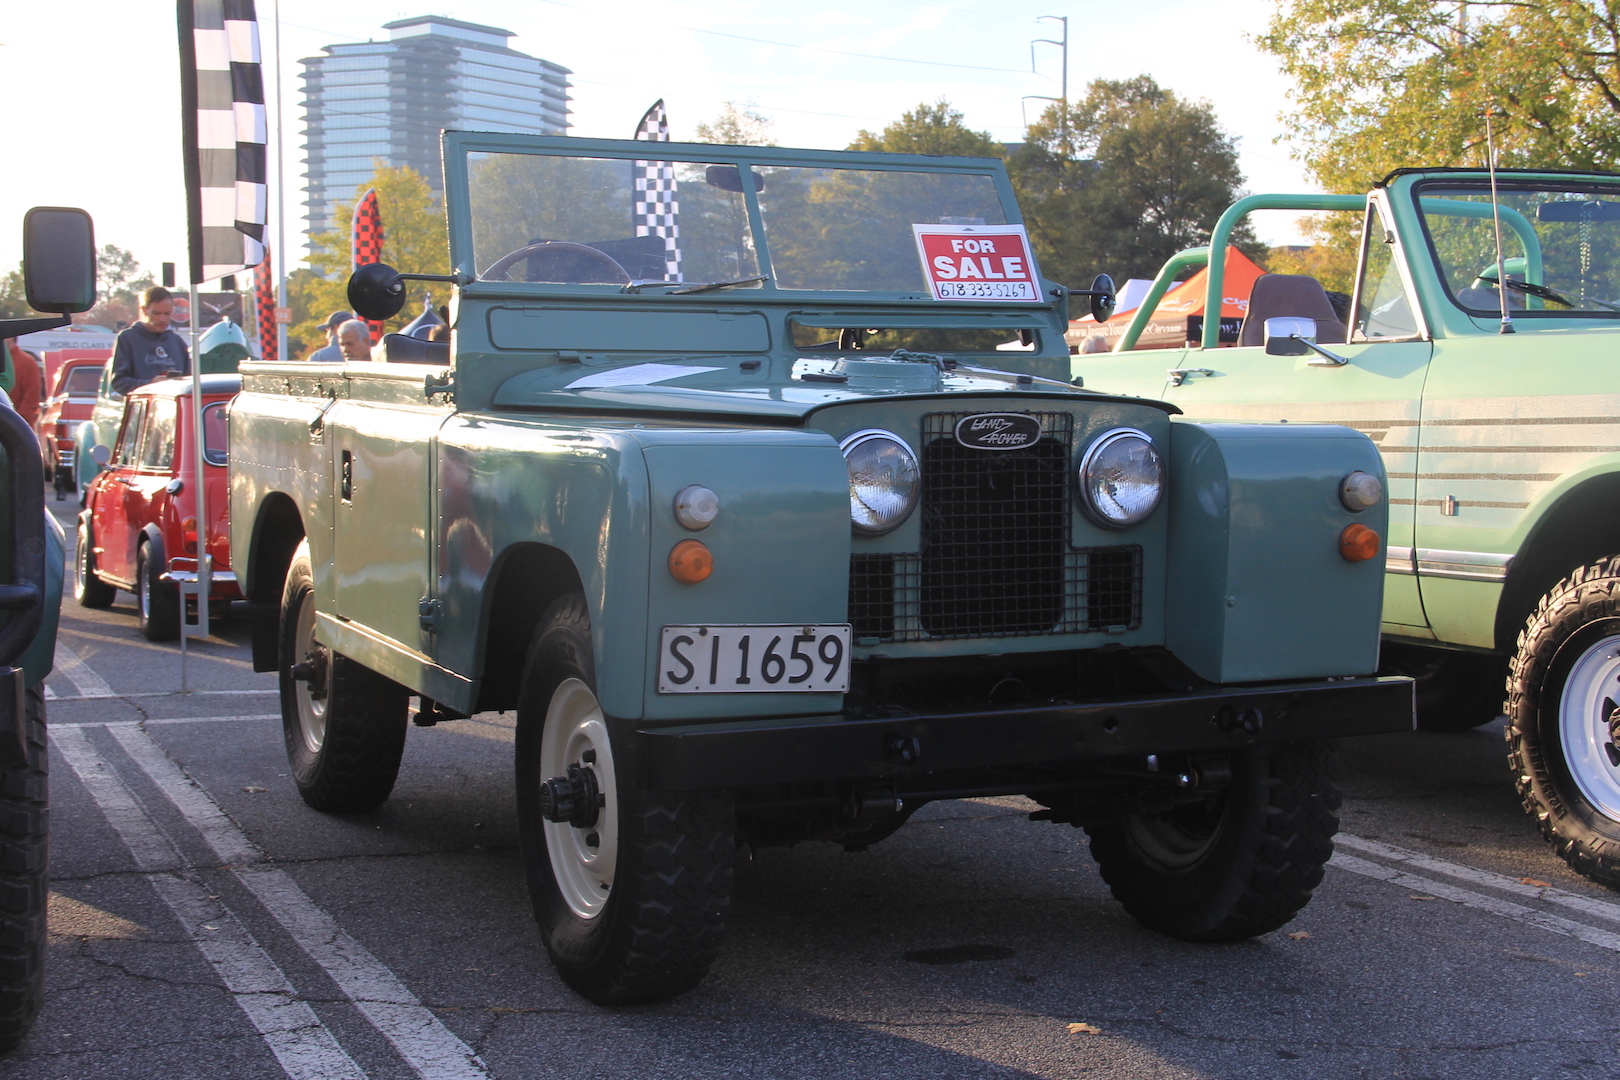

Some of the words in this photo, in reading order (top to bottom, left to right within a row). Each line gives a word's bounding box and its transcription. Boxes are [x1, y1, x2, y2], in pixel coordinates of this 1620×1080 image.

[951, 239, 996, 253] FOR
[933, 255, 1026, 279] SALE
[941, 283, 1026, 297] 678-333-5269
[49, 341, 79, 349] WORLD
[970, 418, 1005, 431] LAND
[988, 433, 1028, 445] ROVER
